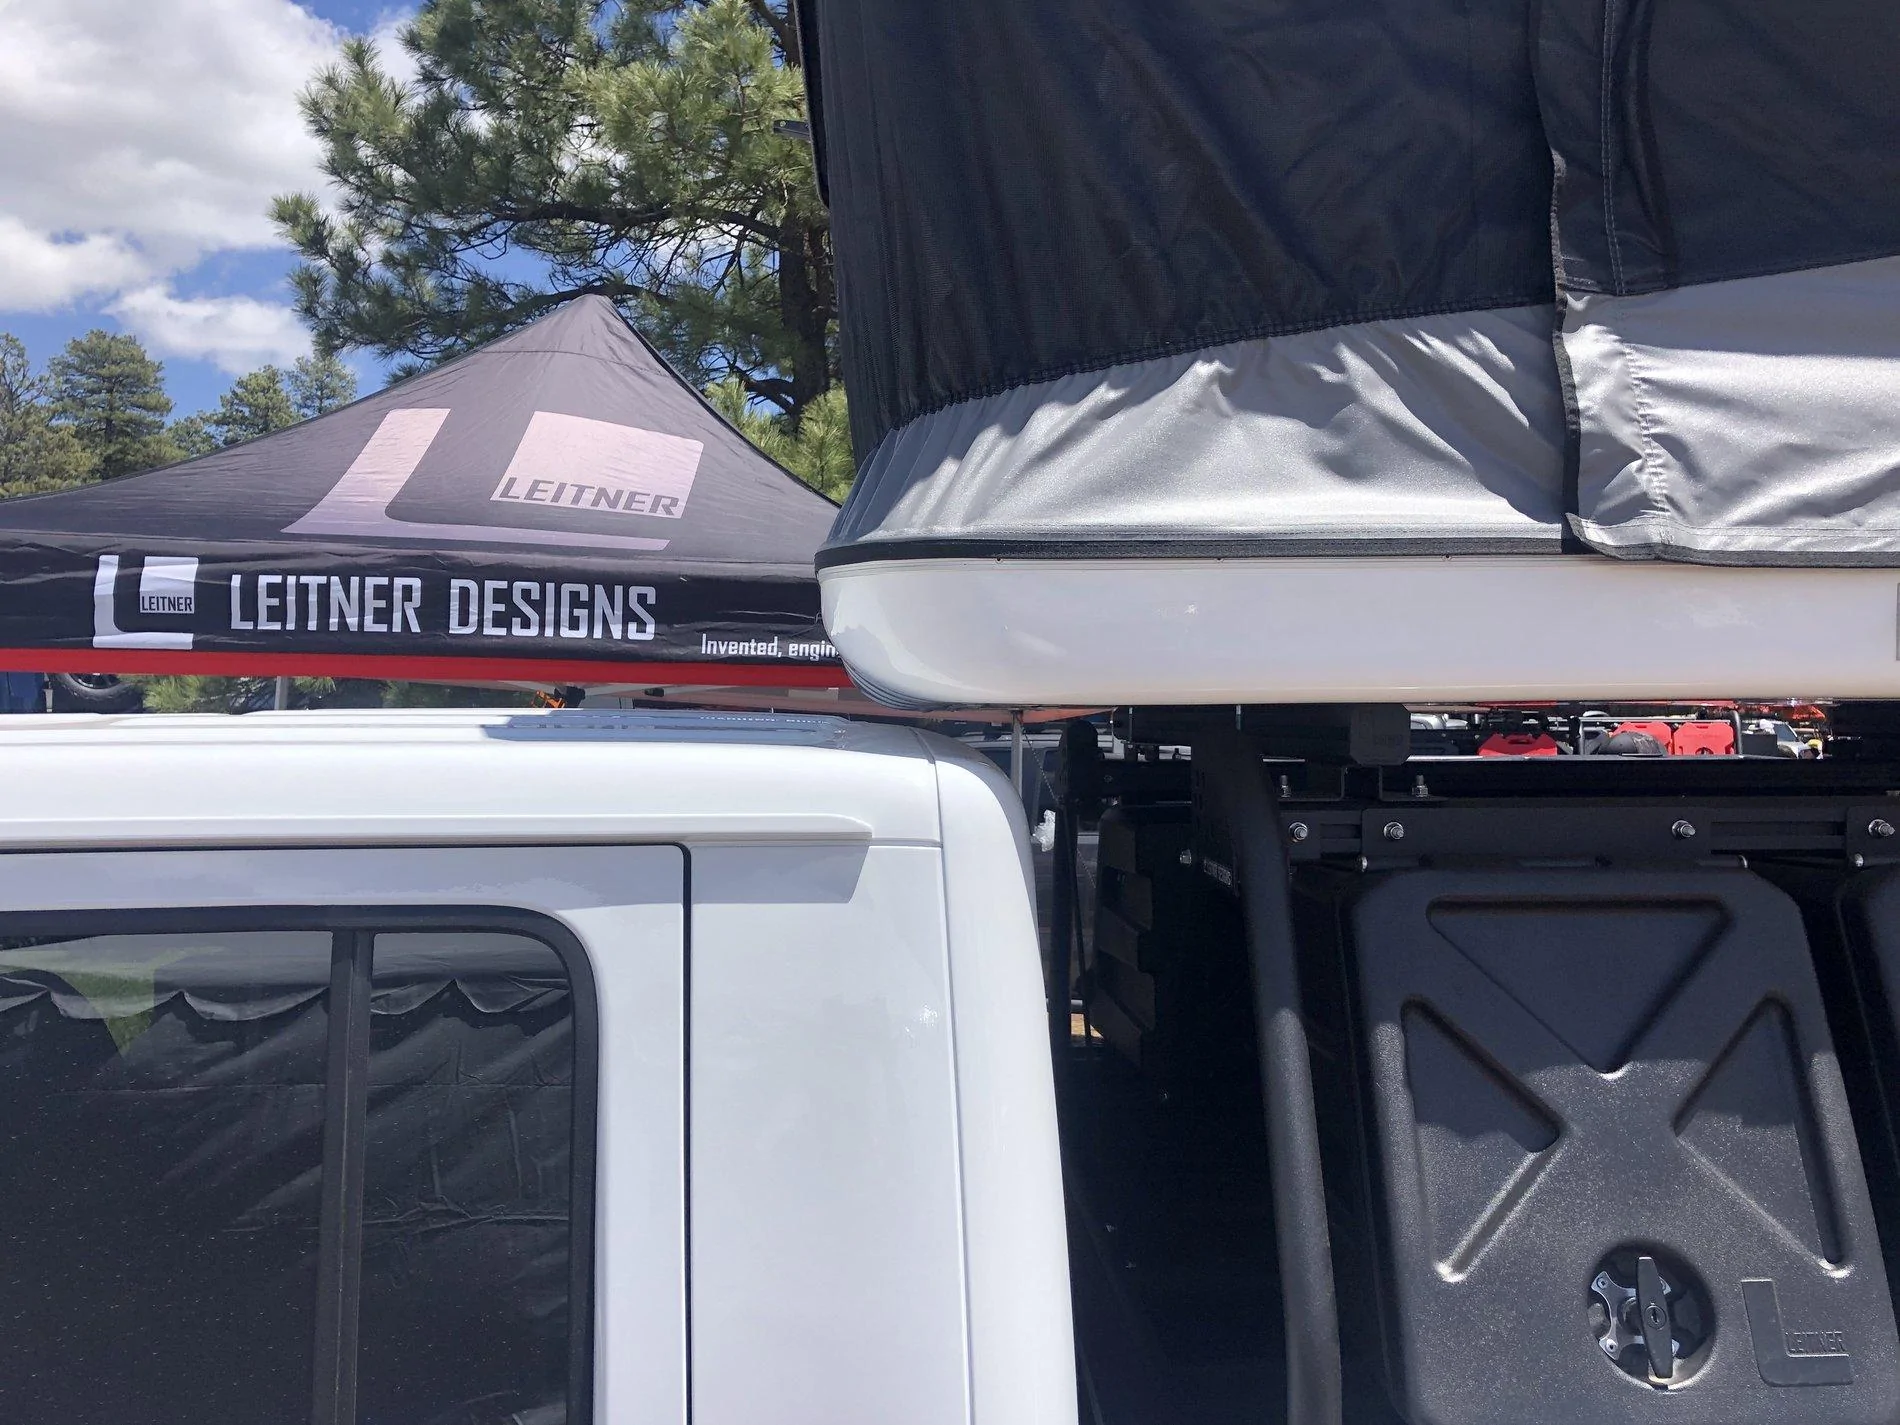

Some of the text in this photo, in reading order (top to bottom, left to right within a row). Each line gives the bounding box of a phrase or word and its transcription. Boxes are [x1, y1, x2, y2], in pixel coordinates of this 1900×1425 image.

[499, 476, 680, 517] LEITNER
[140, 595, 194, 612] LEITNER
[230, 573, 656, 641] LEITNER DESIGNS
[701, 633, 839, 662] Invented, engin
